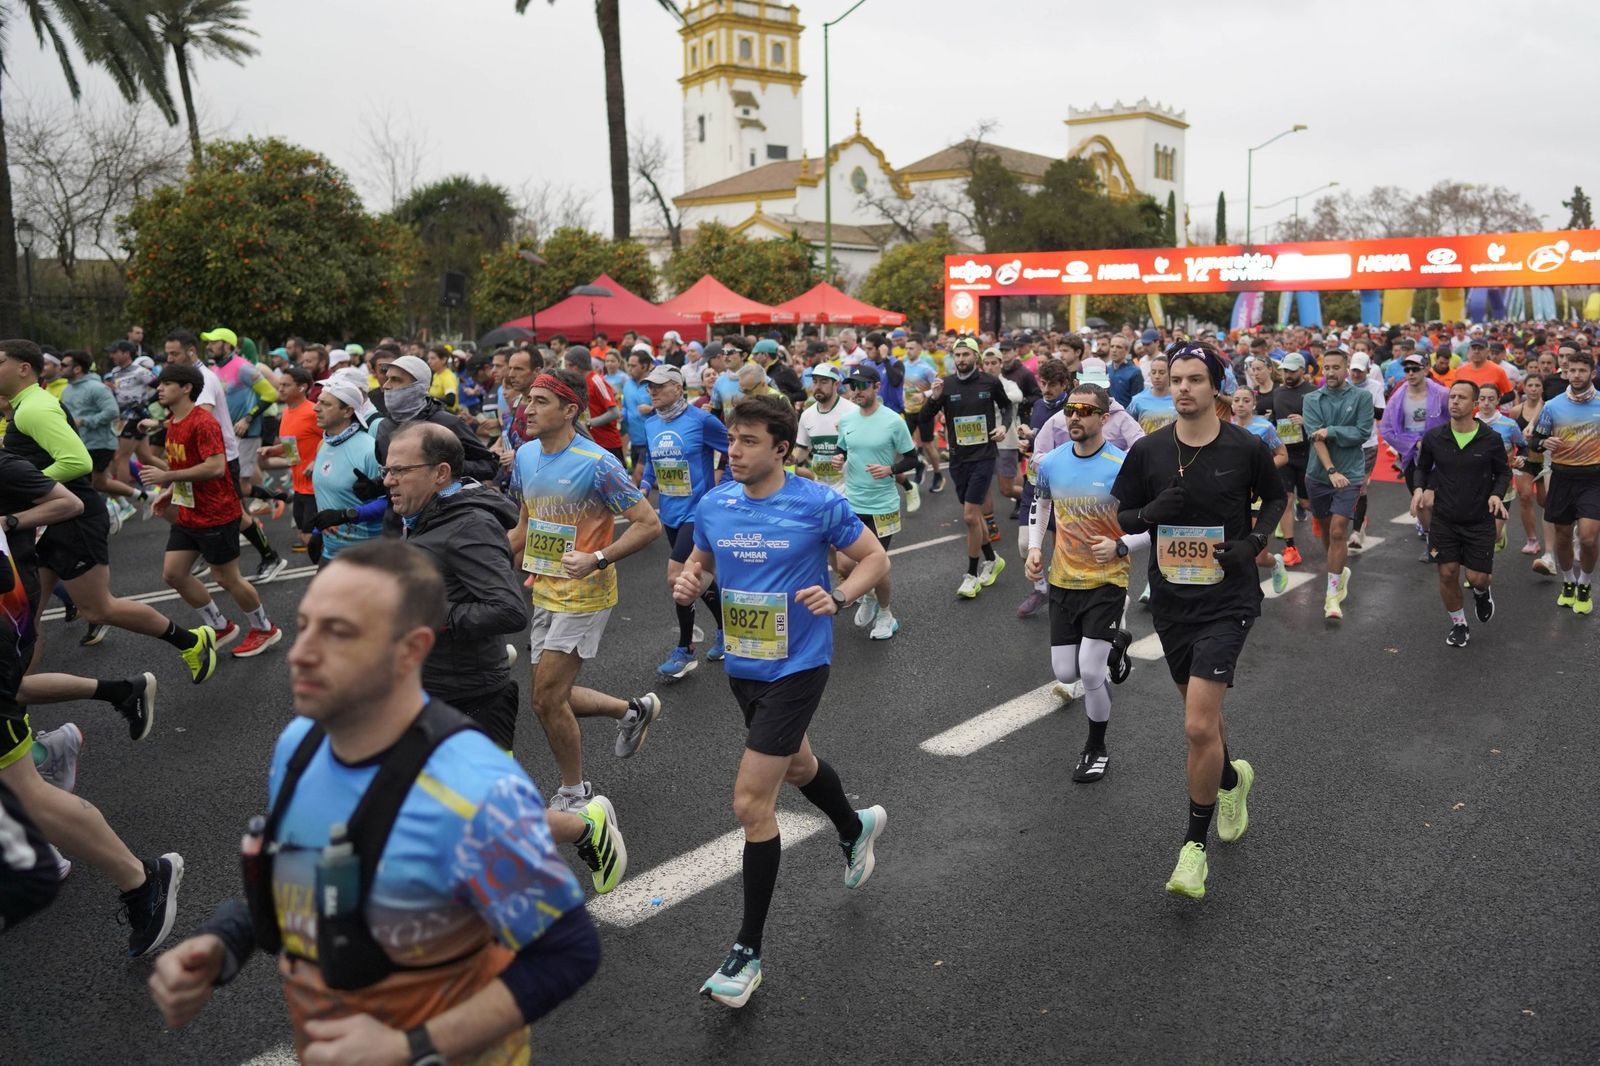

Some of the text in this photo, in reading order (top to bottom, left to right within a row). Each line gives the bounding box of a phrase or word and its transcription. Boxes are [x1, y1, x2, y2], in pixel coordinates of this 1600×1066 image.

[657, 468, 683, 481] 12470
[528, 532, 565, 553] 12373
[734, 533, 762, 541] CLUB
[739, 551, 768, 560] AMBAR
[1167, 540, 1208, 559] 4859
[730, 607, 769, 630] 9827
